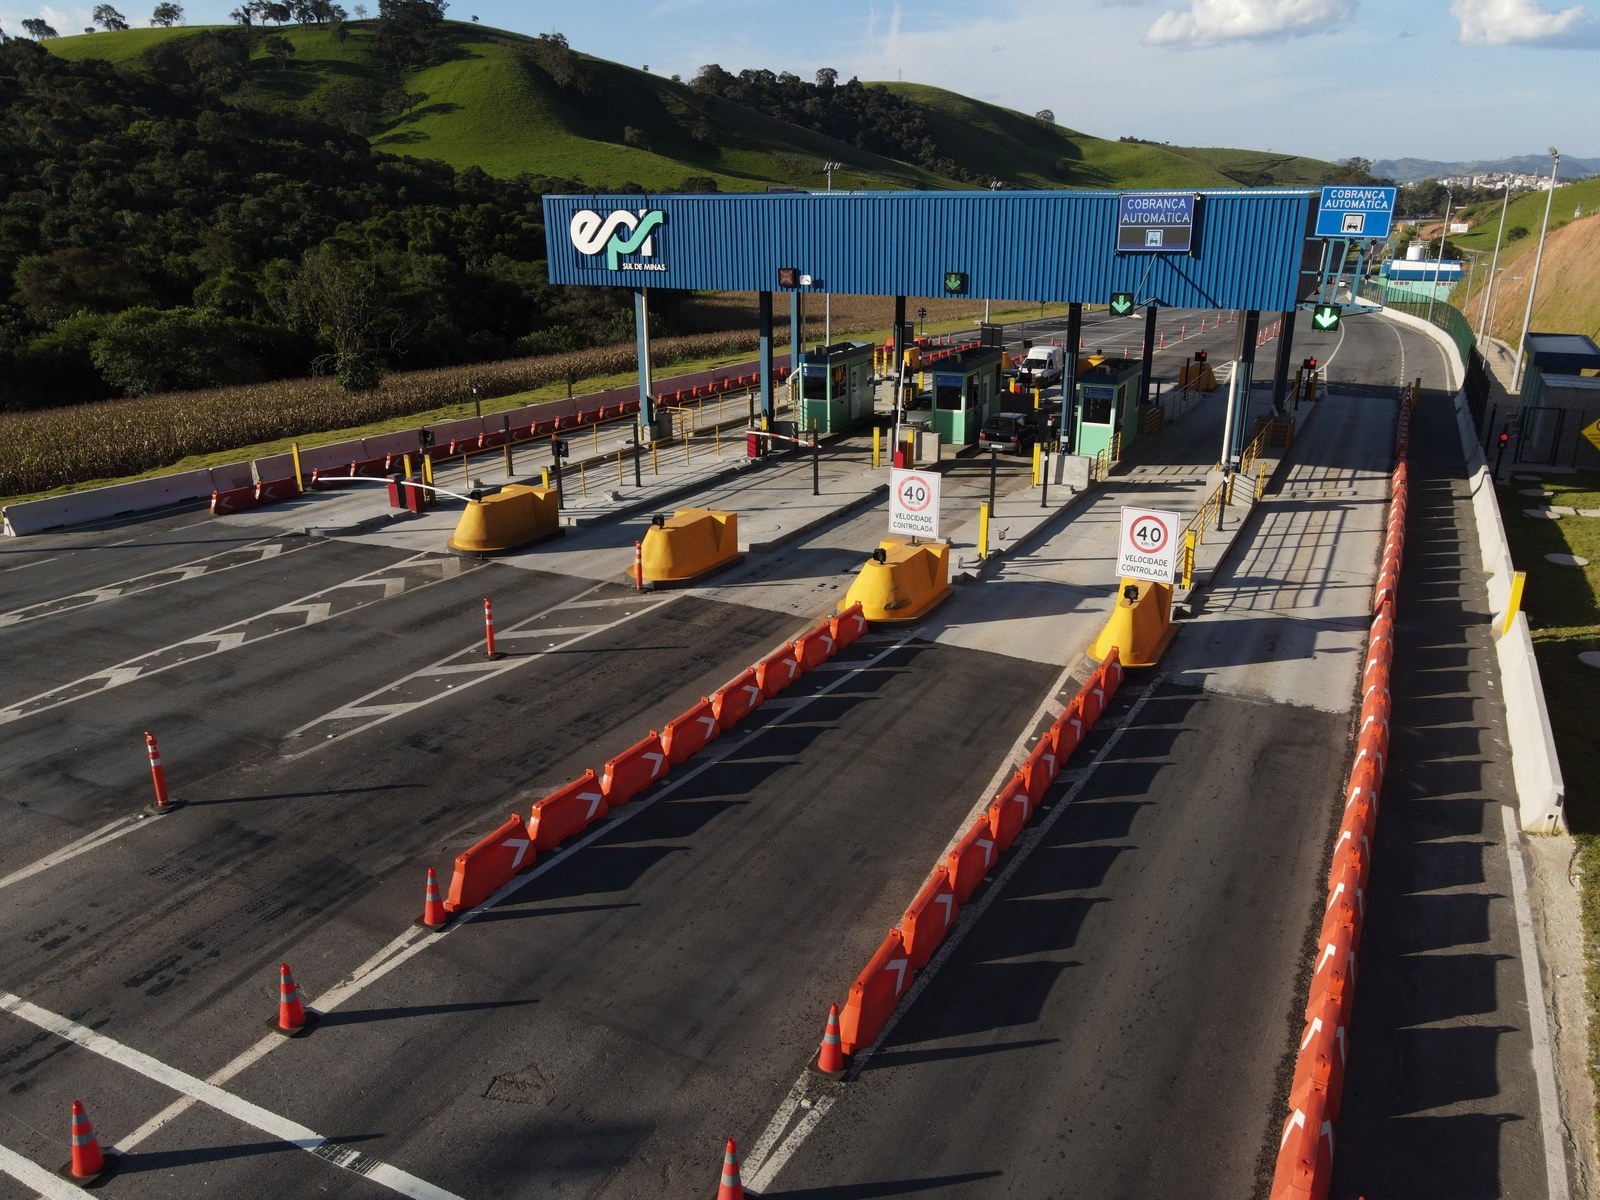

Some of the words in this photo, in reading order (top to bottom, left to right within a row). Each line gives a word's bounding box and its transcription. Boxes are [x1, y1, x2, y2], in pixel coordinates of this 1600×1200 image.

[1331, 189, 1385, 200] COBRANÇA
[1127, 198, 1186, 211] COBRANÇA
[1325, 198, 1388, 209] AUTOMÁTICA
[1122, 209, 1190, 223] AUTOMÁTICA
[622, 262, 633, 270] SUL
[643, 263, 665, 271] MINAS
[904, 486, 925, 501] 40
[895, 512, 932, 523] VELOCIDADE
[893, 521, 934, 532] CONTROLADA
[1136, 526, 1161, 542] 40
[1125, 554, 1168, 567] VELOCIDADE
[1121, 564, 1168, 577] CONTROLADA
